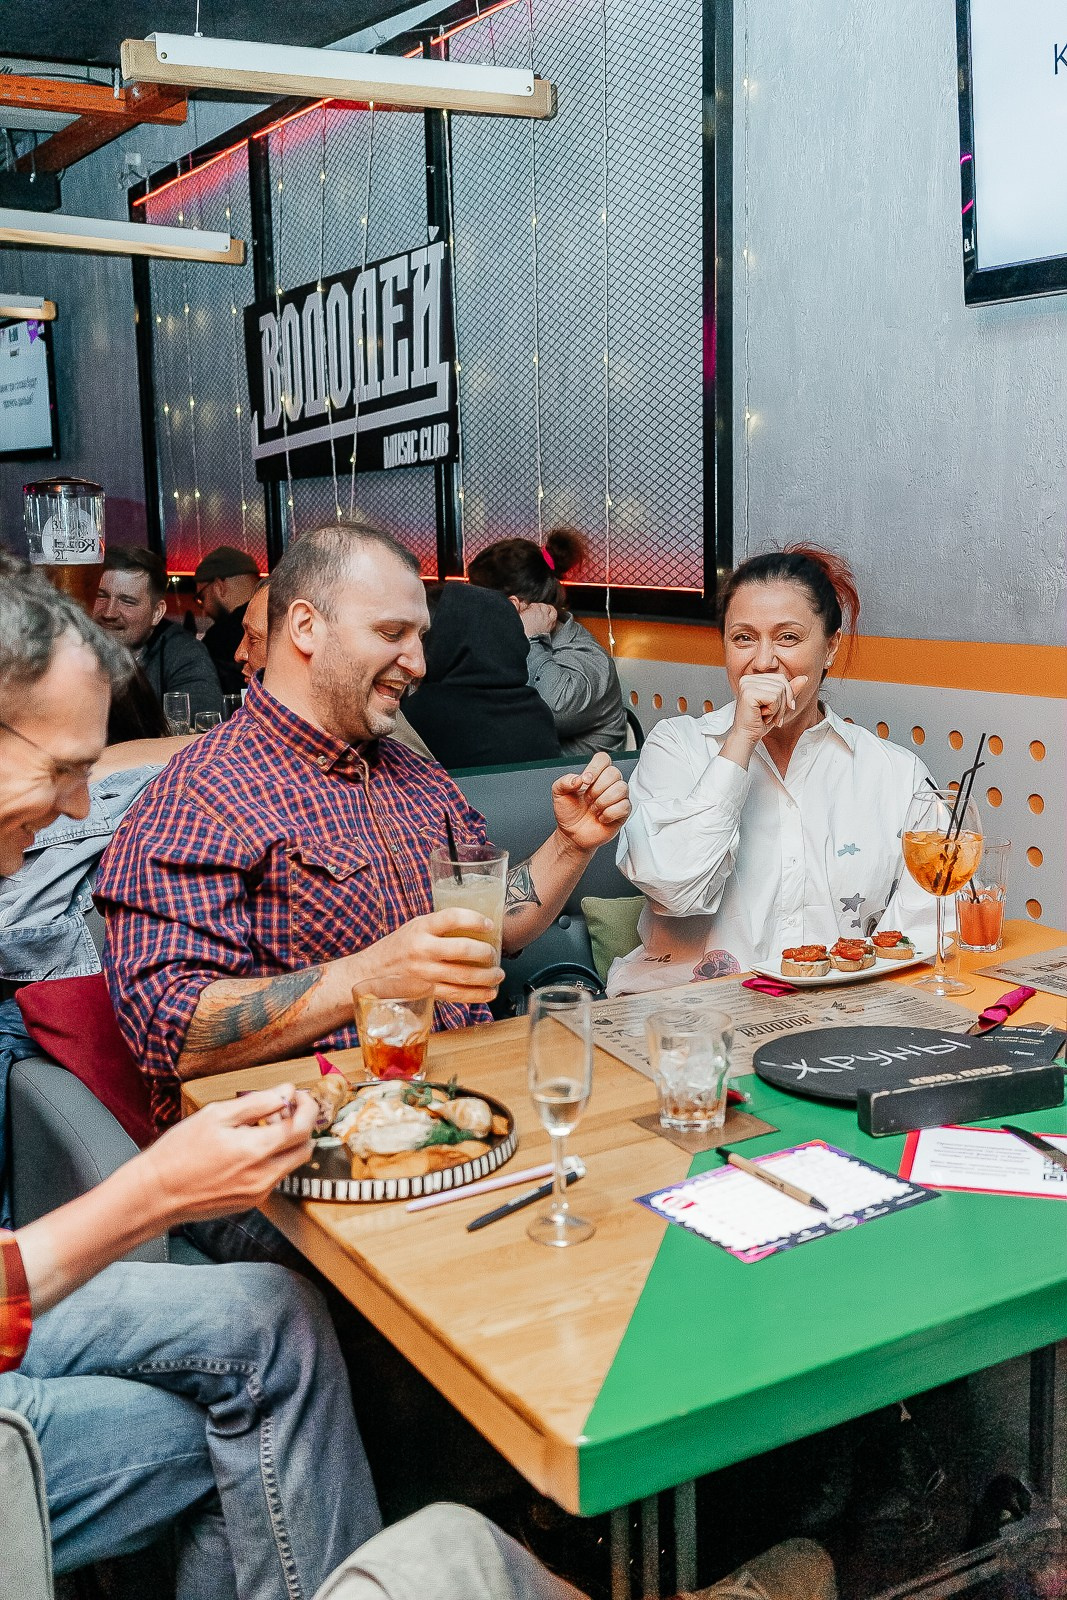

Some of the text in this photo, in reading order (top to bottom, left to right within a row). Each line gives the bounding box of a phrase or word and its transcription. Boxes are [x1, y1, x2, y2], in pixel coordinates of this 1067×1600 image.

[259, 226, 445, 430] ВОДОЛЕЙ
[383, 422, 450, 469] MUSIC CLUB
